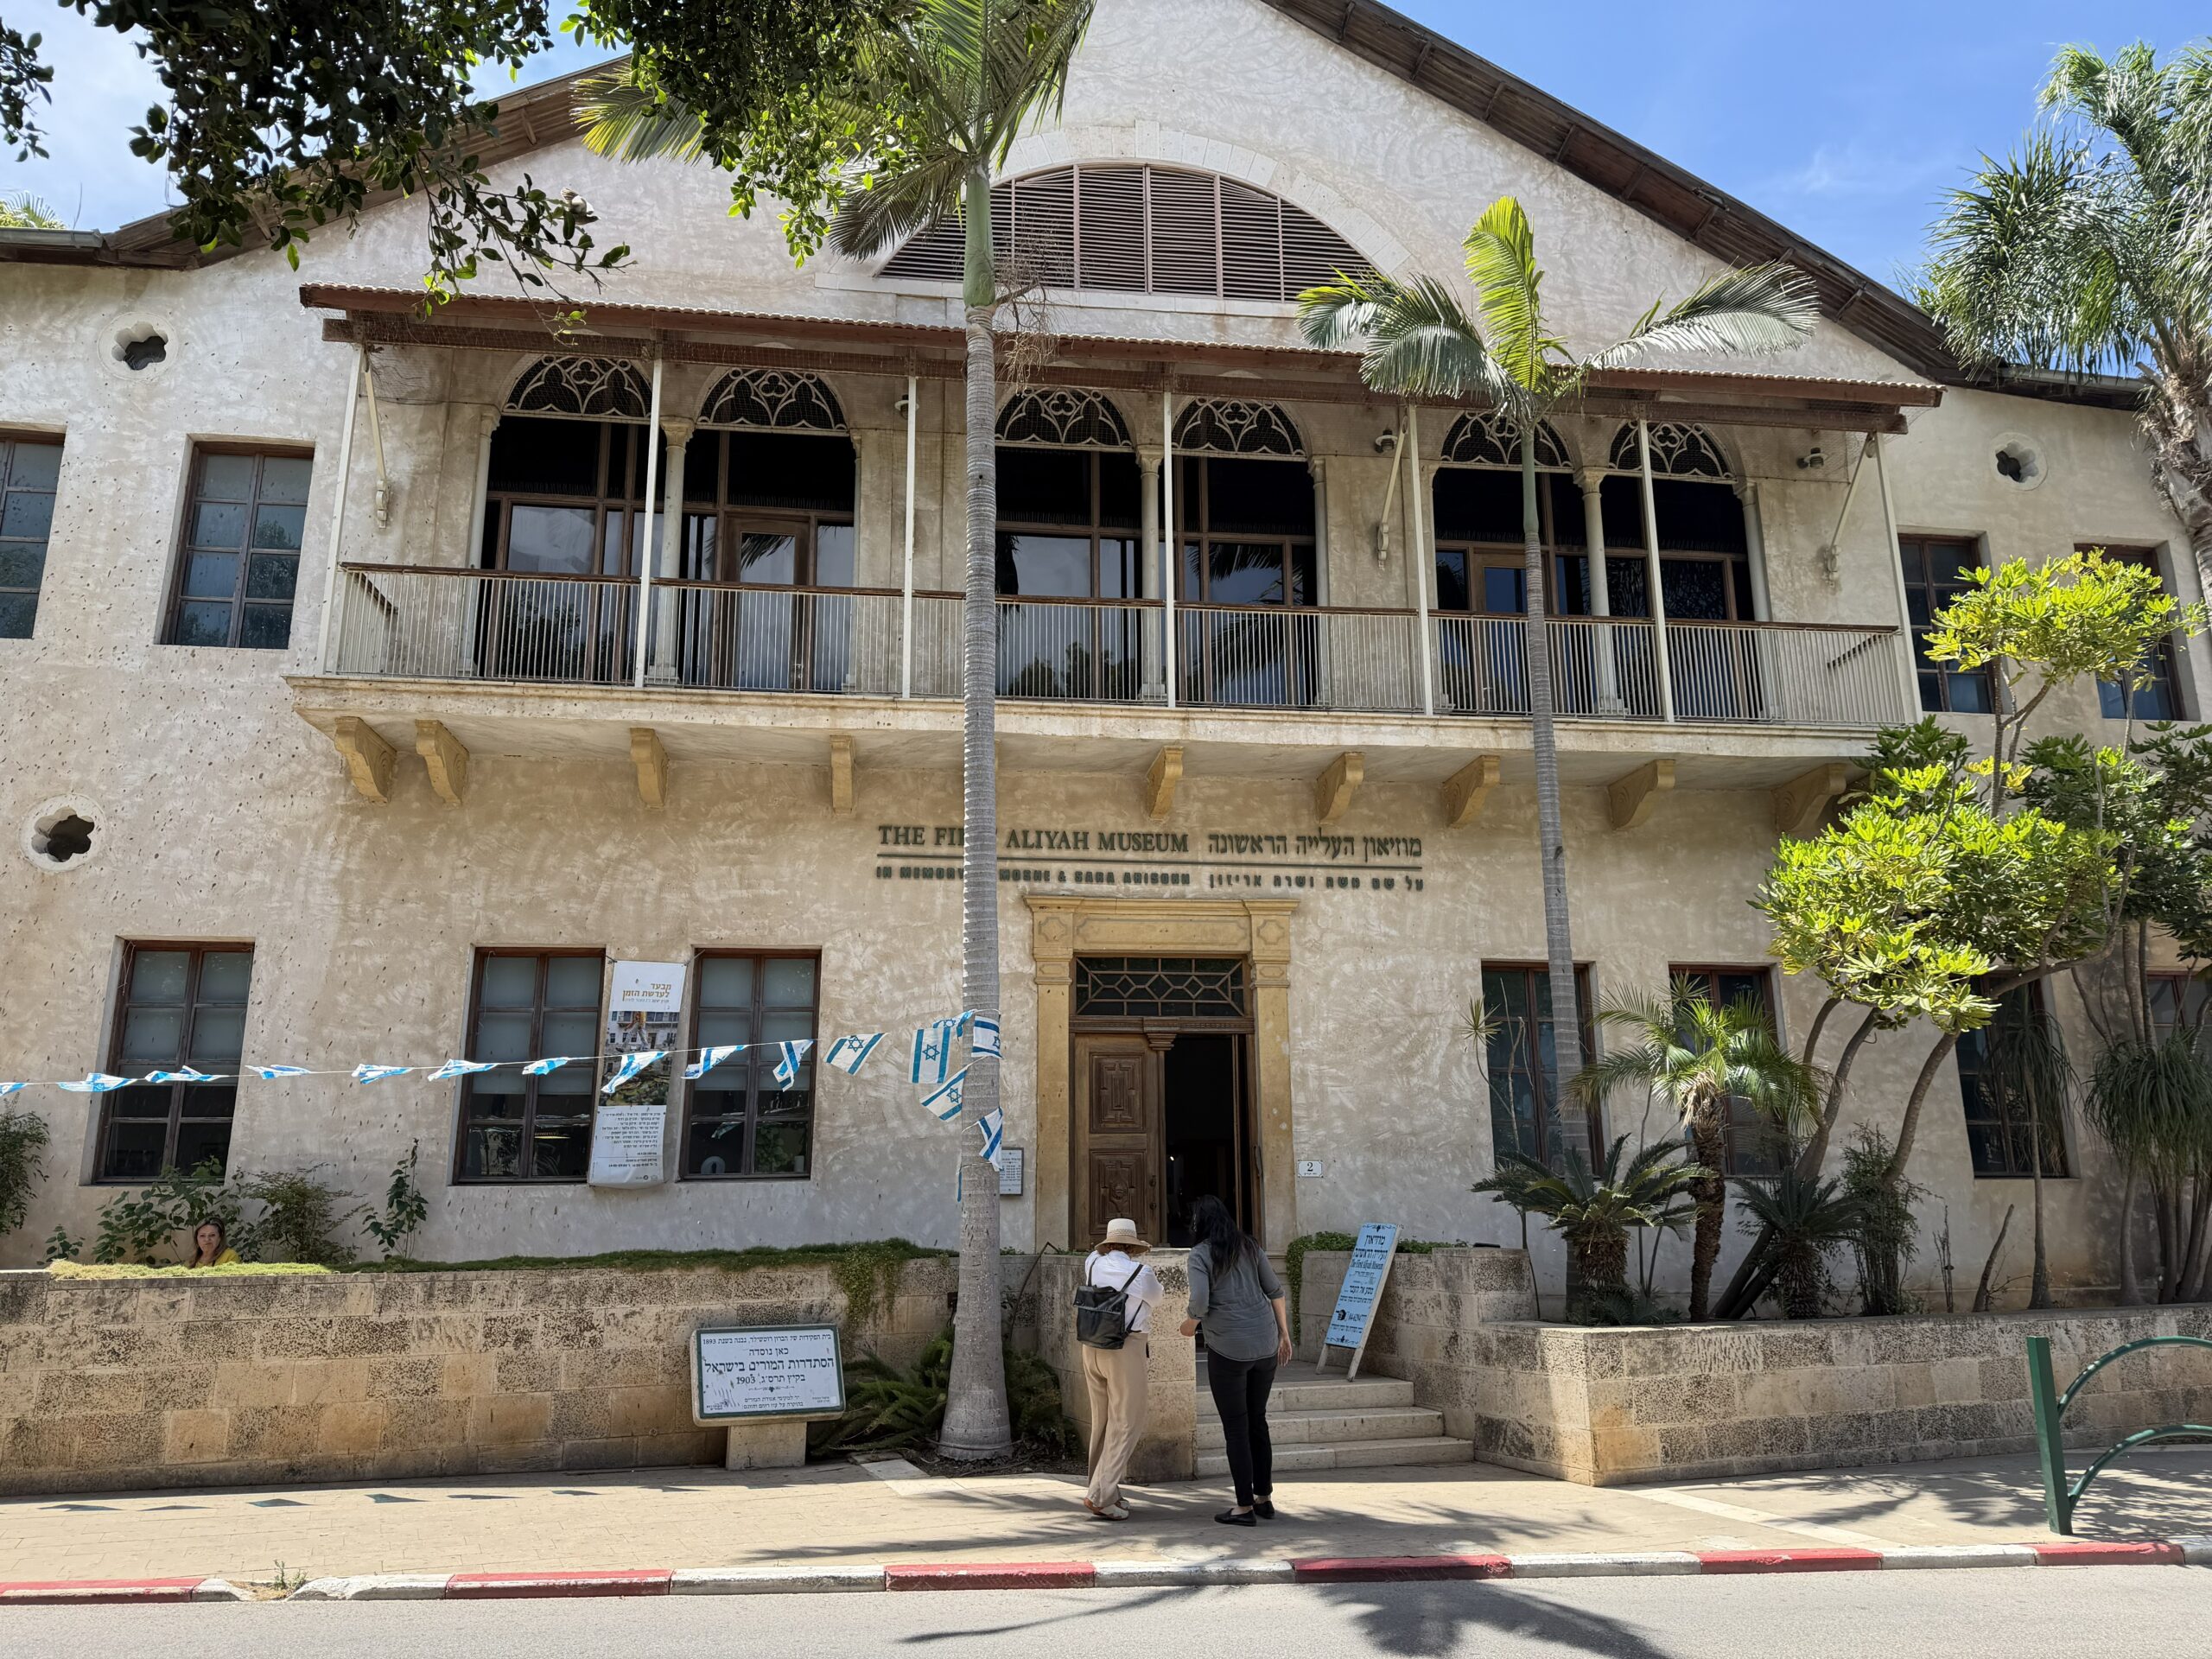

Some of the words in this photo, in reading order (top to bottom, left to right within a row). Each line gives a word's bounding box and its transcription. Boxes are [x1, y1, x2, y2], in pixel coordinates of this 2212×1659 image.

[878, 826, 925, 846] THE
[1006, 829, 1090, 850] ALIYAH
[1097, 831, 1190, 853] MUSEUM
[1208, 833, 1287, 855] הראשונה
[1296, 826, 1355, 861] העלייה
[1363, 836, 1422, 863] מוזיאון
[876, 867, 892, 879] IN
[999, 868, 1051, 881] MOSHE
[1058, 870, 1067, 882] &
[1074, 870, 1116, 884] SARA
[1210, 873, 1262, 889] אריזון
[1273, 874, 1314, 888] ושרה
[1325, 875, 1361, 889] משה
[1371, 877, 1395, 891] שם
[1405, 875, 1424, 892] על
[1307, 1162, 1313, 1172] 2
[749, 1348, 772, 1357] נוסדה
[775, 1347, 789, 1357] כאן
[704, 1358, 746, 1373] בישראל
[748, 1360, 785, 1371] המורים
[788, 1357, 835, 1370] הסתדרות
[787, 1374, 805, 1384] בקיץ
